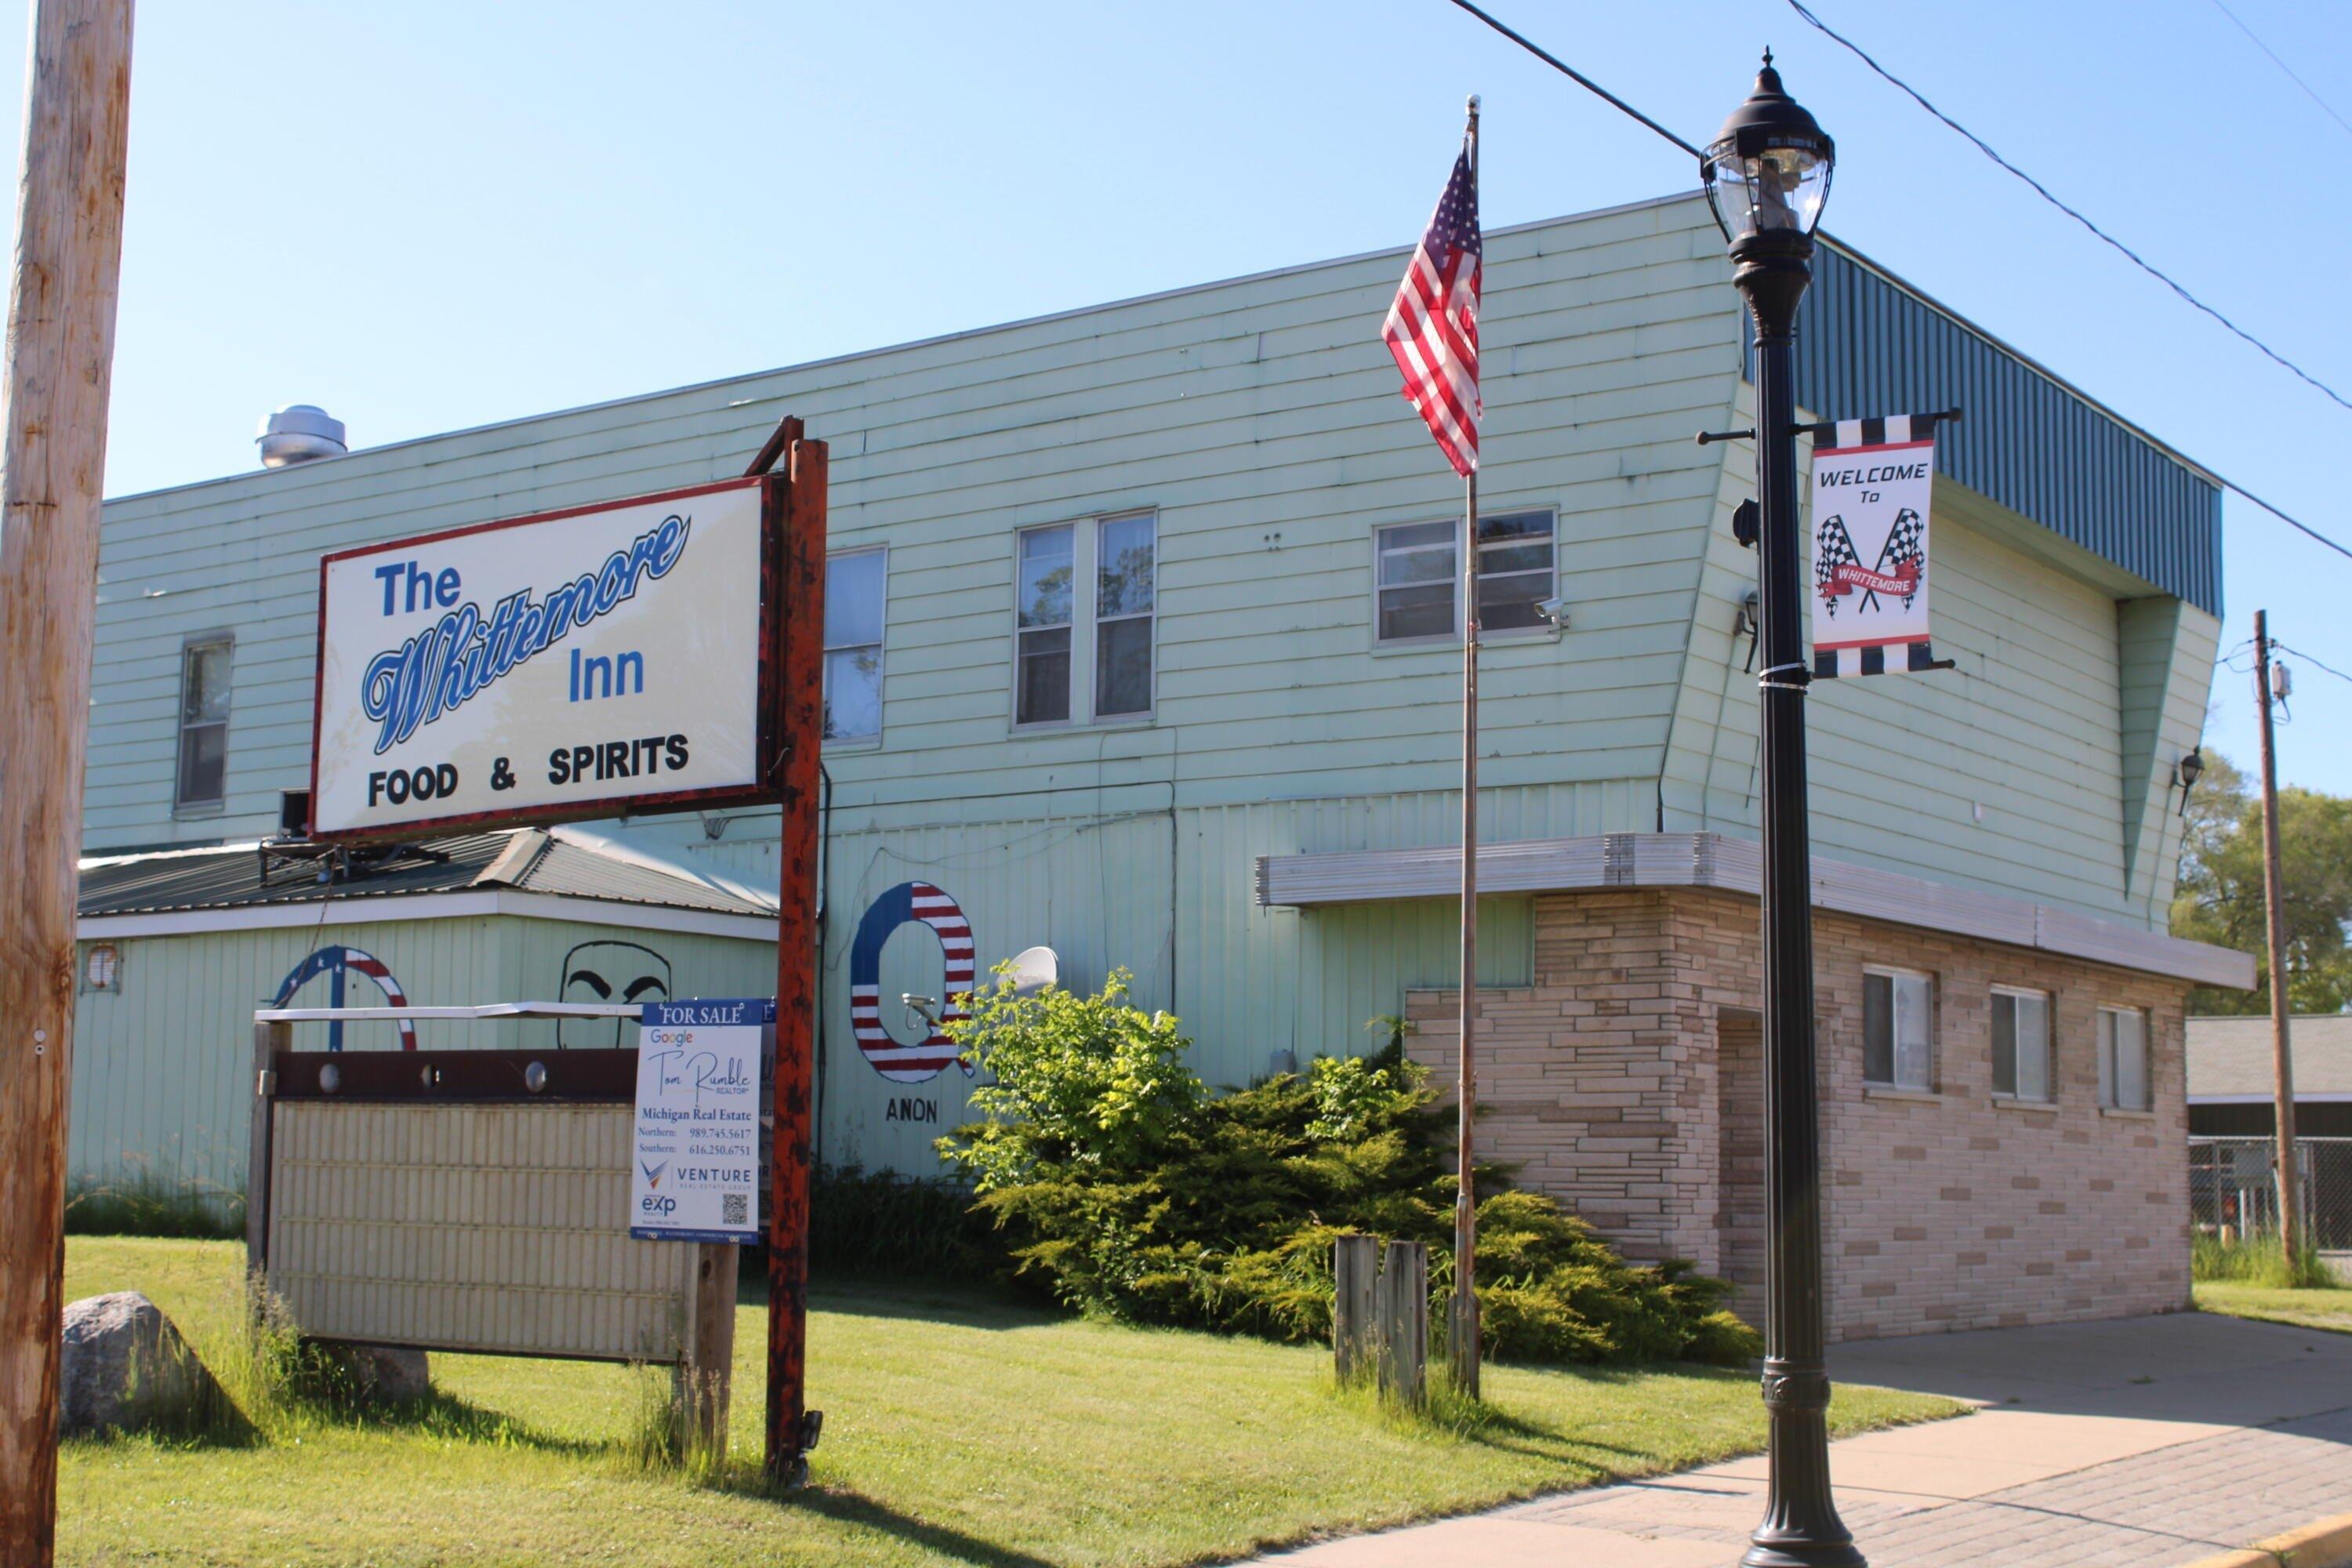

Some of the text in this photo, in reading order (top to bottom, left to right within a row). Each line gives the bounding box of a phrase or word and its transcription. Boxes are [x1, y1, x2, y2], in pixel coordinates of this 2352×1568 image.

[1820, 463, 1929, 488] WELCOME
[374, 560, 461, 616] The
[1838, 568, 1911, 593] WHITTEMORE
[361, 514, 691, 755] Whittemore
[569, 648, 644, 702] Inn
[368, 733, 689, 807] FOOD & SPIRITS
[851, 880, 975, 1084] Q
[662, 1007, 741, 1024] FOR SALE
[651, 1029, 693, 1047] Google
[648, 1051, 684, 1096] Tom
[686, 1051, 750, 1105] Rumble
[641, 1108, 689, 1123] Michigan
[693, 1108, 716, 1120] Real
[720, 1109, 751, 1121] Estate
[886, 1098, 937, 1123] ANON
[638, 1127, 751, 1139] Northern: 989.745.5617
[639, 1143, 677, 1152] Southern:
[689, 1145, 750, 1156] 616.250.6751
[677, 1168, 751, 1182] VENTURE
